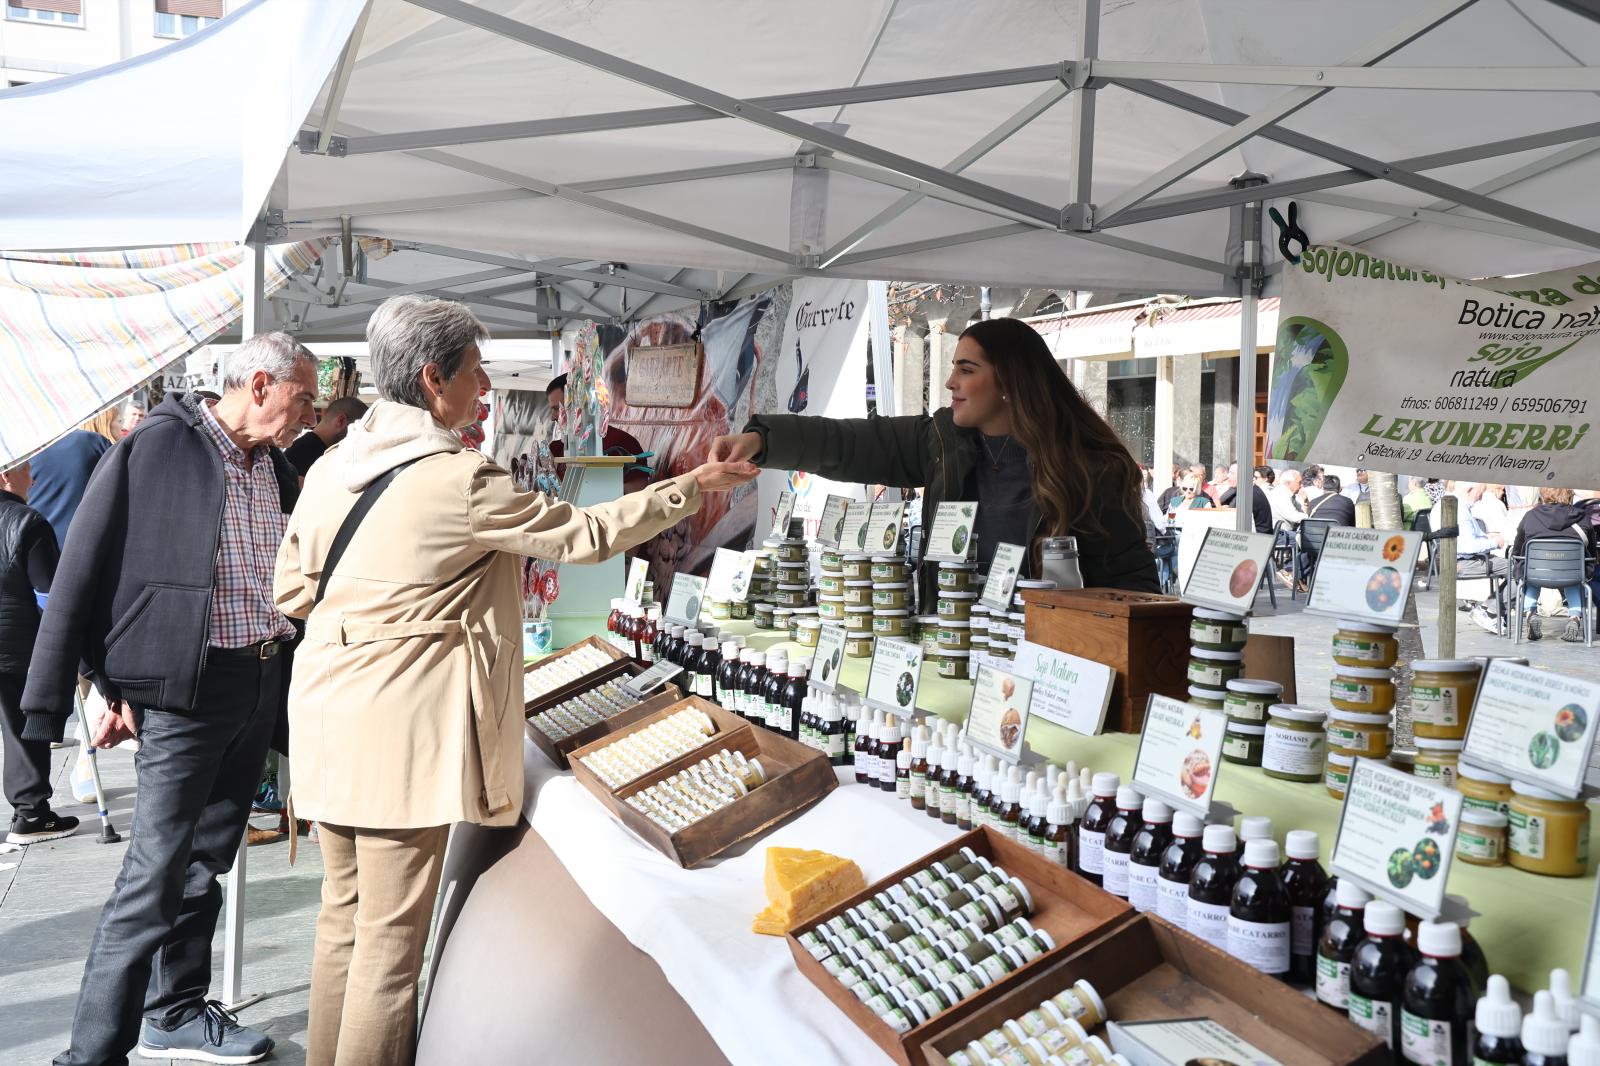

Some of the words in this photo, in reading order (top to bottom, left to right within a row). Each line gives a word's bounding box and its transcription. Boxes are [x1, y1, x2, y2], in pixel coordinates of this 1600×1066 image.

[1572, 274, 1600, 295] d
[1458, 299, 1546, 330] Botica
[1551, 305, 1600, 330] nat
[1450, 366, 1518, 388] natura
[1401, 396, 1431, 410] tfnos:
[1434, 396, 1498, 412] 606811249
[1500, 396, 1508, 414] /
[1511, 397, 1588, 414] 659506791
[1406, 448, 1422, 461] 19
[1425, 449, 1489, 467] Lekunberri
[1489, 454, 1550, 472] (Navarra)
[1242, 928, 1287, 940] CATARRO
